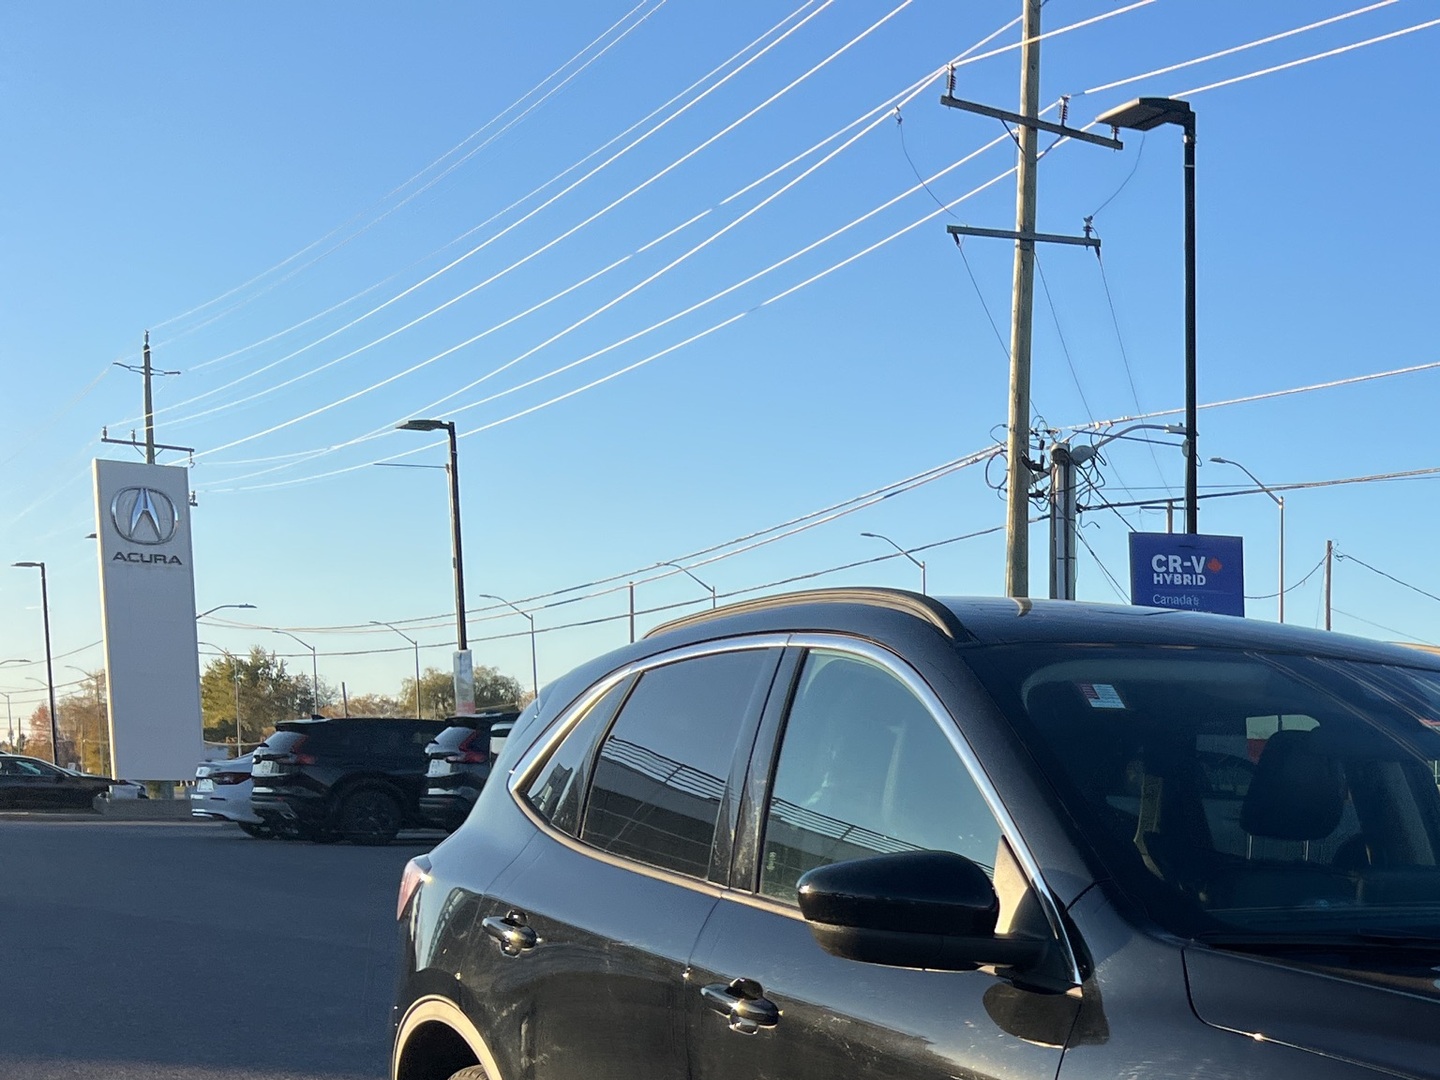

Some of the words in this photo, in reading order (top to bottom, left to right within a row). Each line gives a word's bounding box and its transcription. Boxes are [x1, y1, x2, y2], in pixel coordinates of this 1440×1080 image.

[112, 551, 183, 566] ACURA
[1151, 554, 1206, 573] CR-V
[1153, 573, 1206, 586] HYBRID
